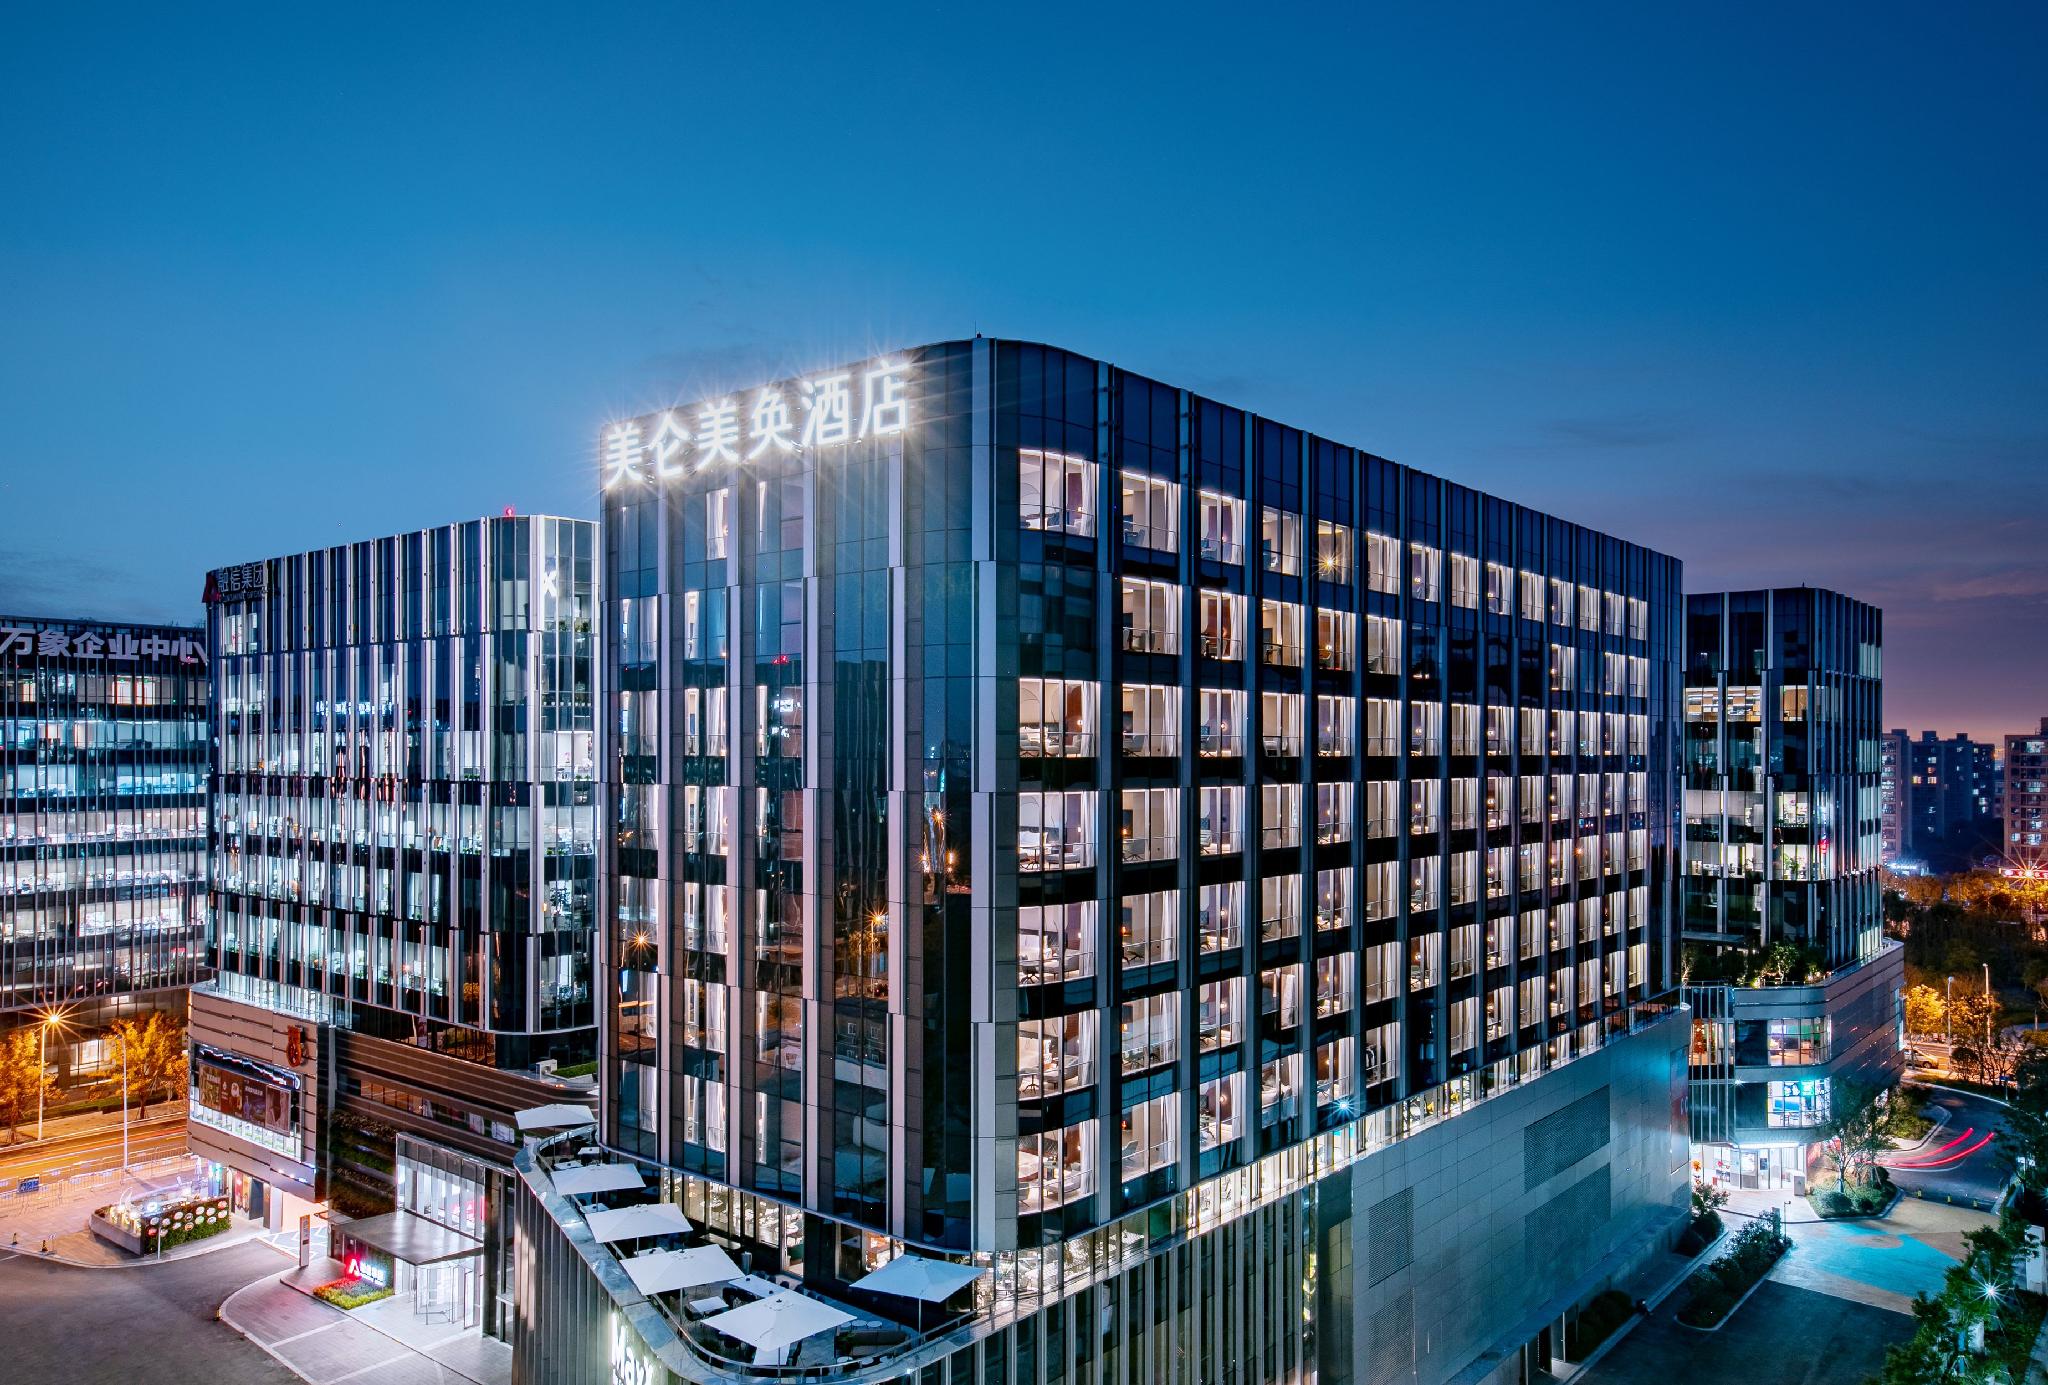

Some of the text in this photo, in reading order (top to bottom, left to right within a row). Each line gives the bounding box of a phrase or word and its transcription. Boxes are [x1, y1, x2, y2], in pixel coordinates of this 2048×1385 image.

[606, 361, 911, 488] 美仑美奂酒店
[0, 627, 209, 666] 万象企业中心
